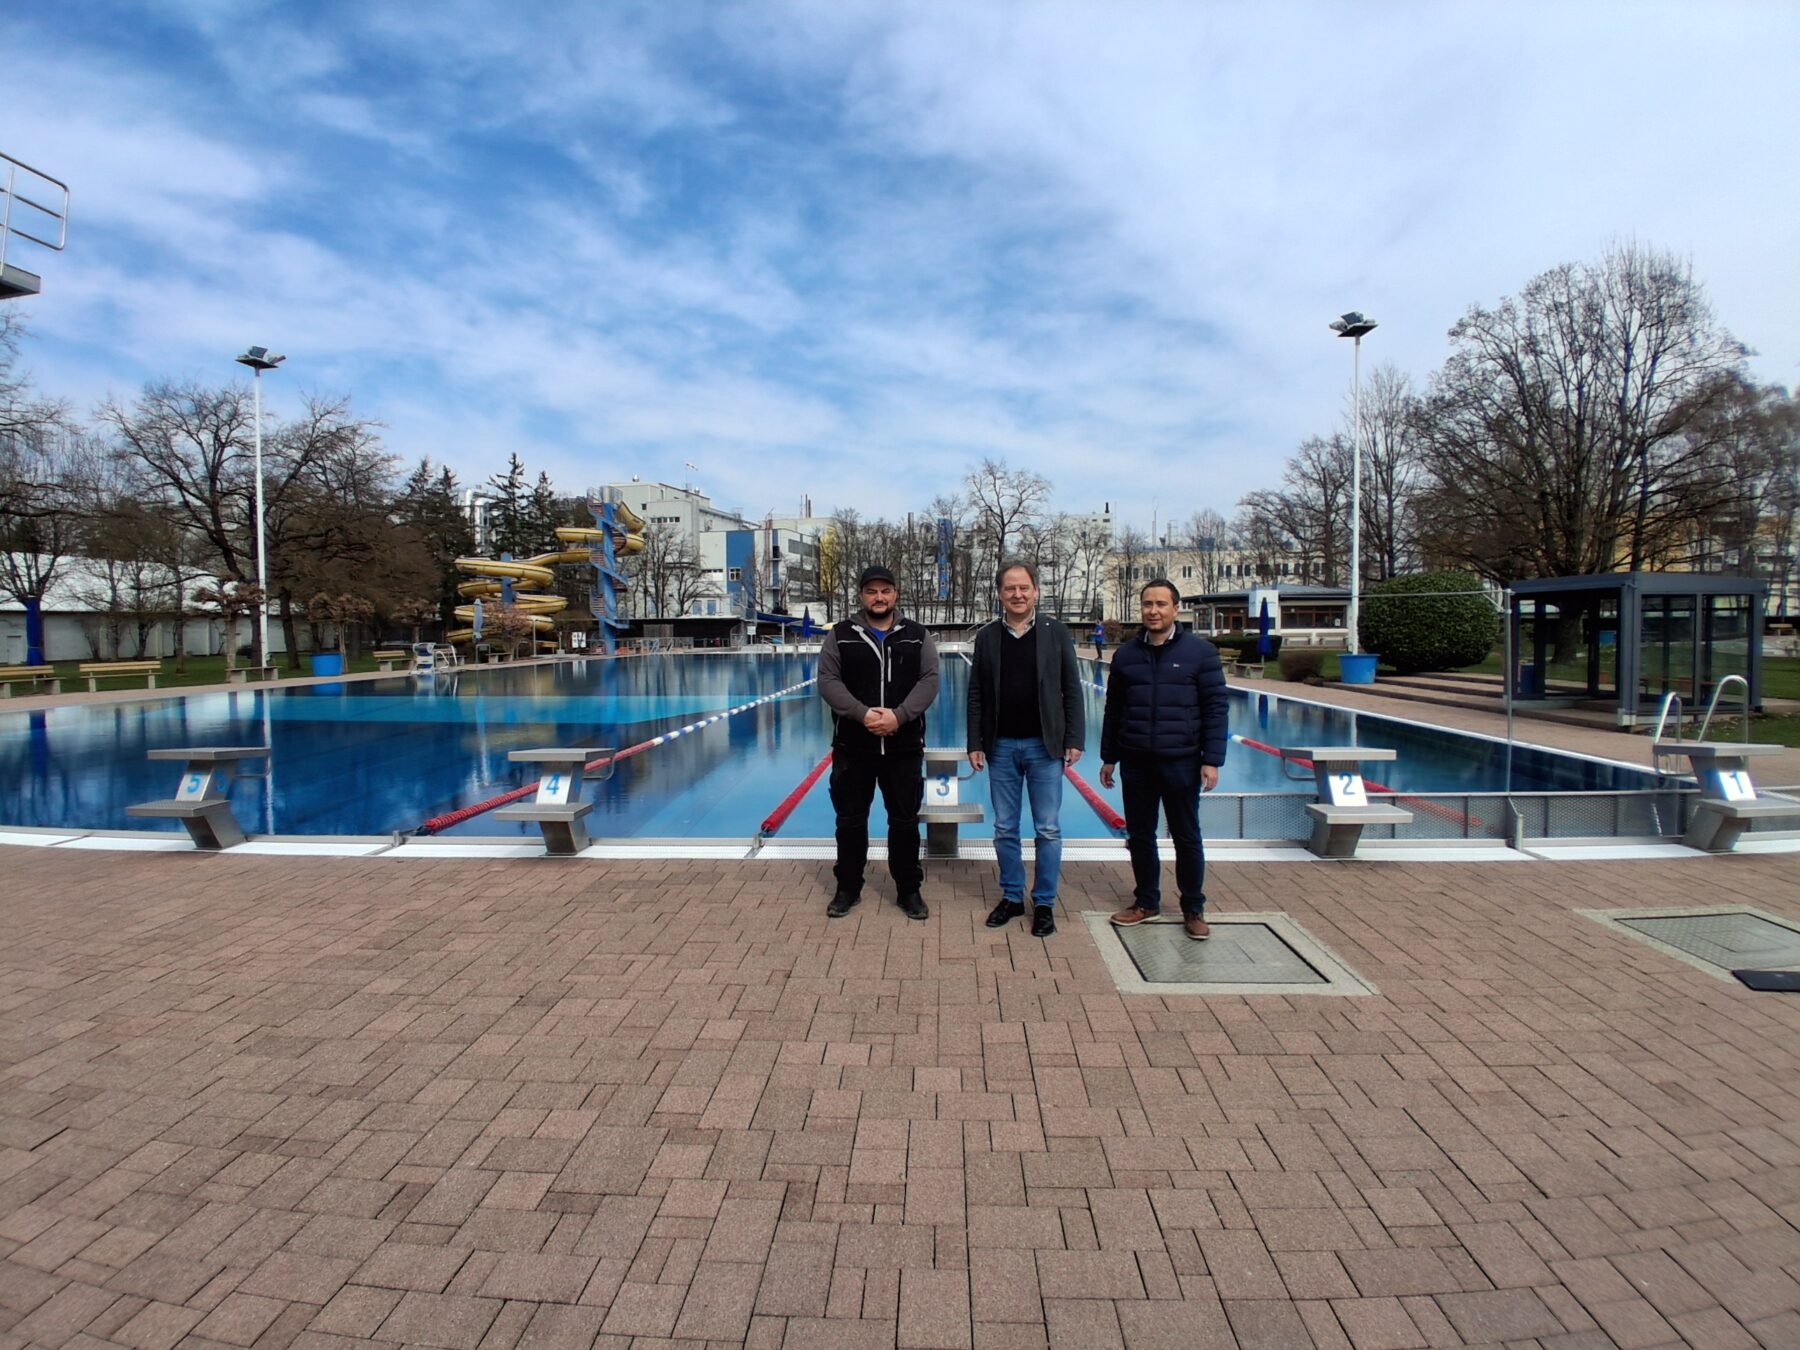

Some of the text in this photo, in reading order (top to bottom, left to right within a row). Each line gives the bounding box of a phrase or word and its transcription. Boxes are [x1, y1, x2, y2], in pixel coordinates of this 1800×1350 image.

[187, 771, 202, 794] 5
[546, 772, 562, 796] 4
[936, 773, 950, 797] 3
[1338, 772, 1356, 796] 2
[1729, 770, 1745, 795] 1
